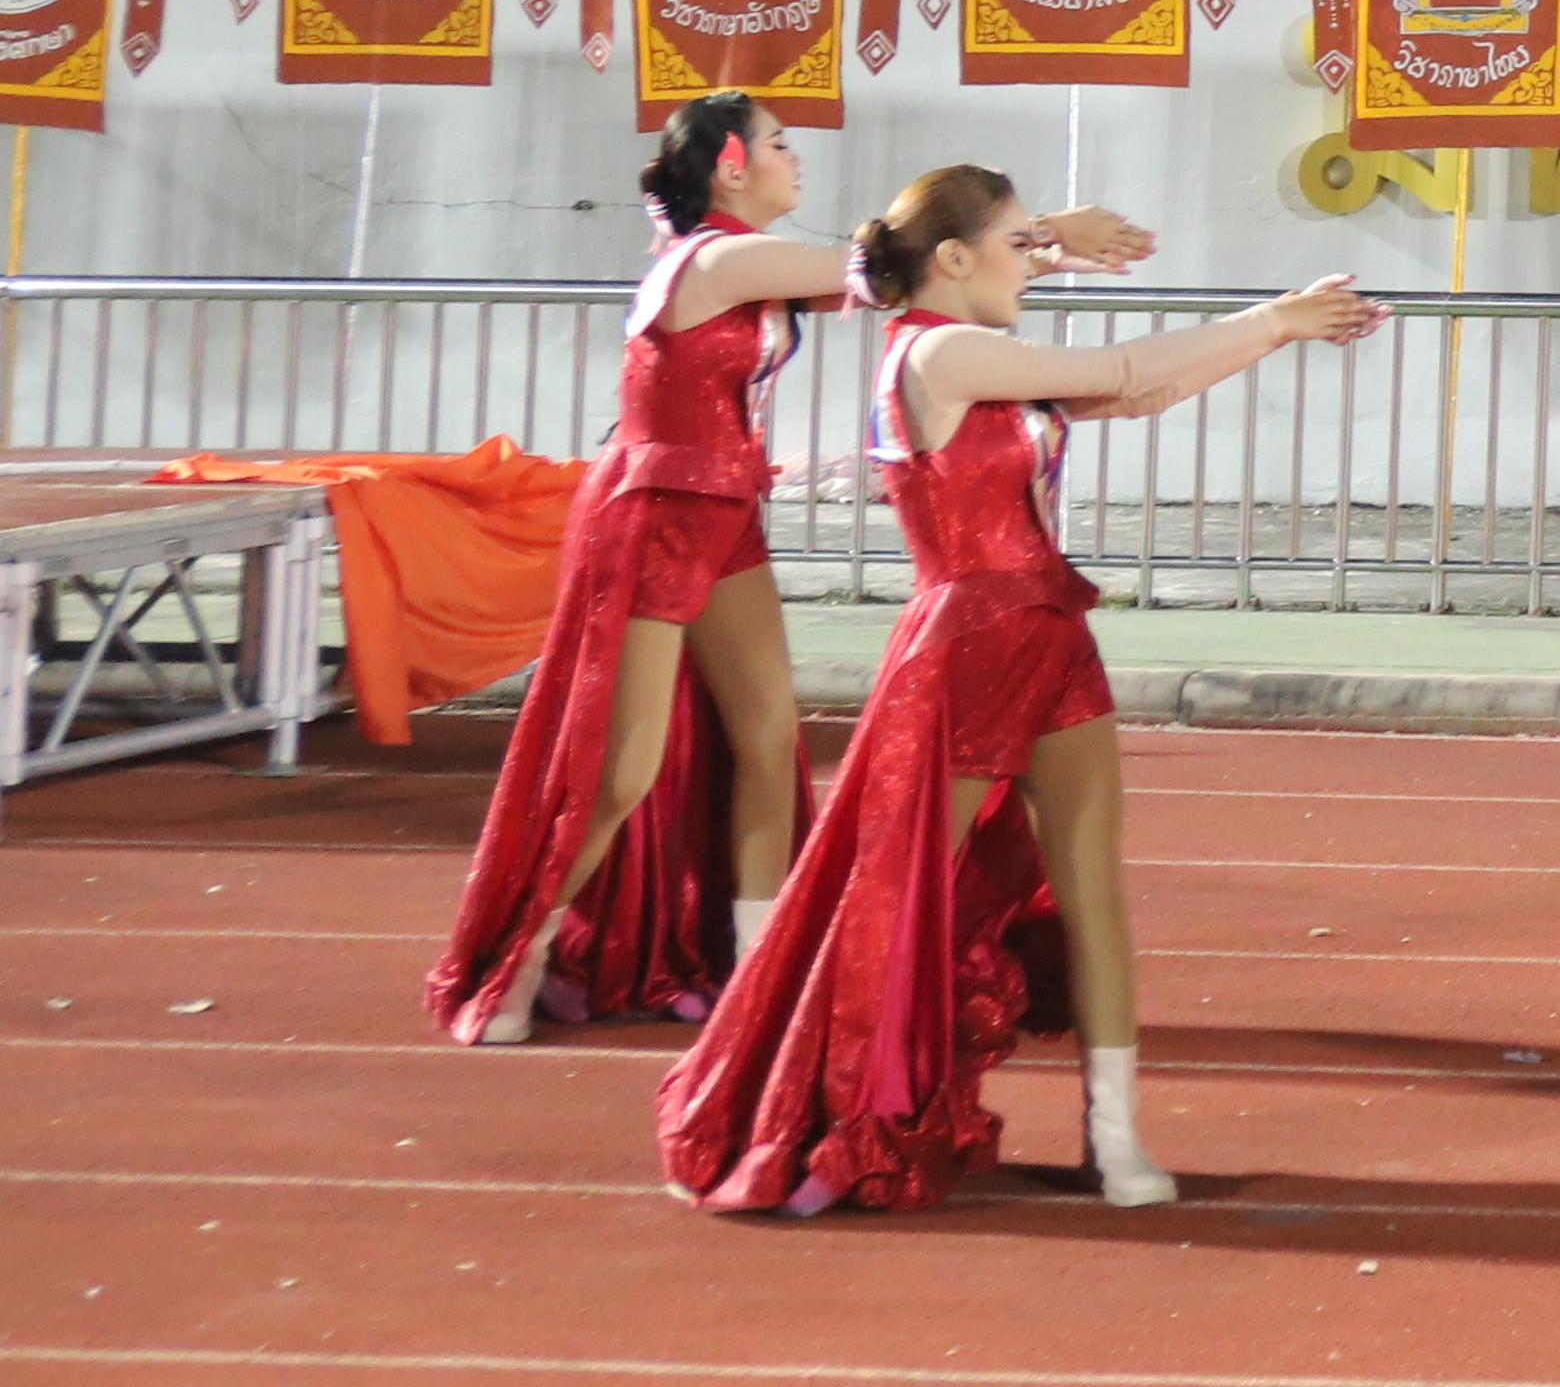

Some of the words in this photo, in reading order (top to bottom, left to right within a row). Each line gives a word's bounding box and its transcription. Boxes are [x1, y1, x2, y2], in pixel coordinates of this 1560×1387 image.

[1393, 39, 1531, 89] วิชาภาษาไทย
